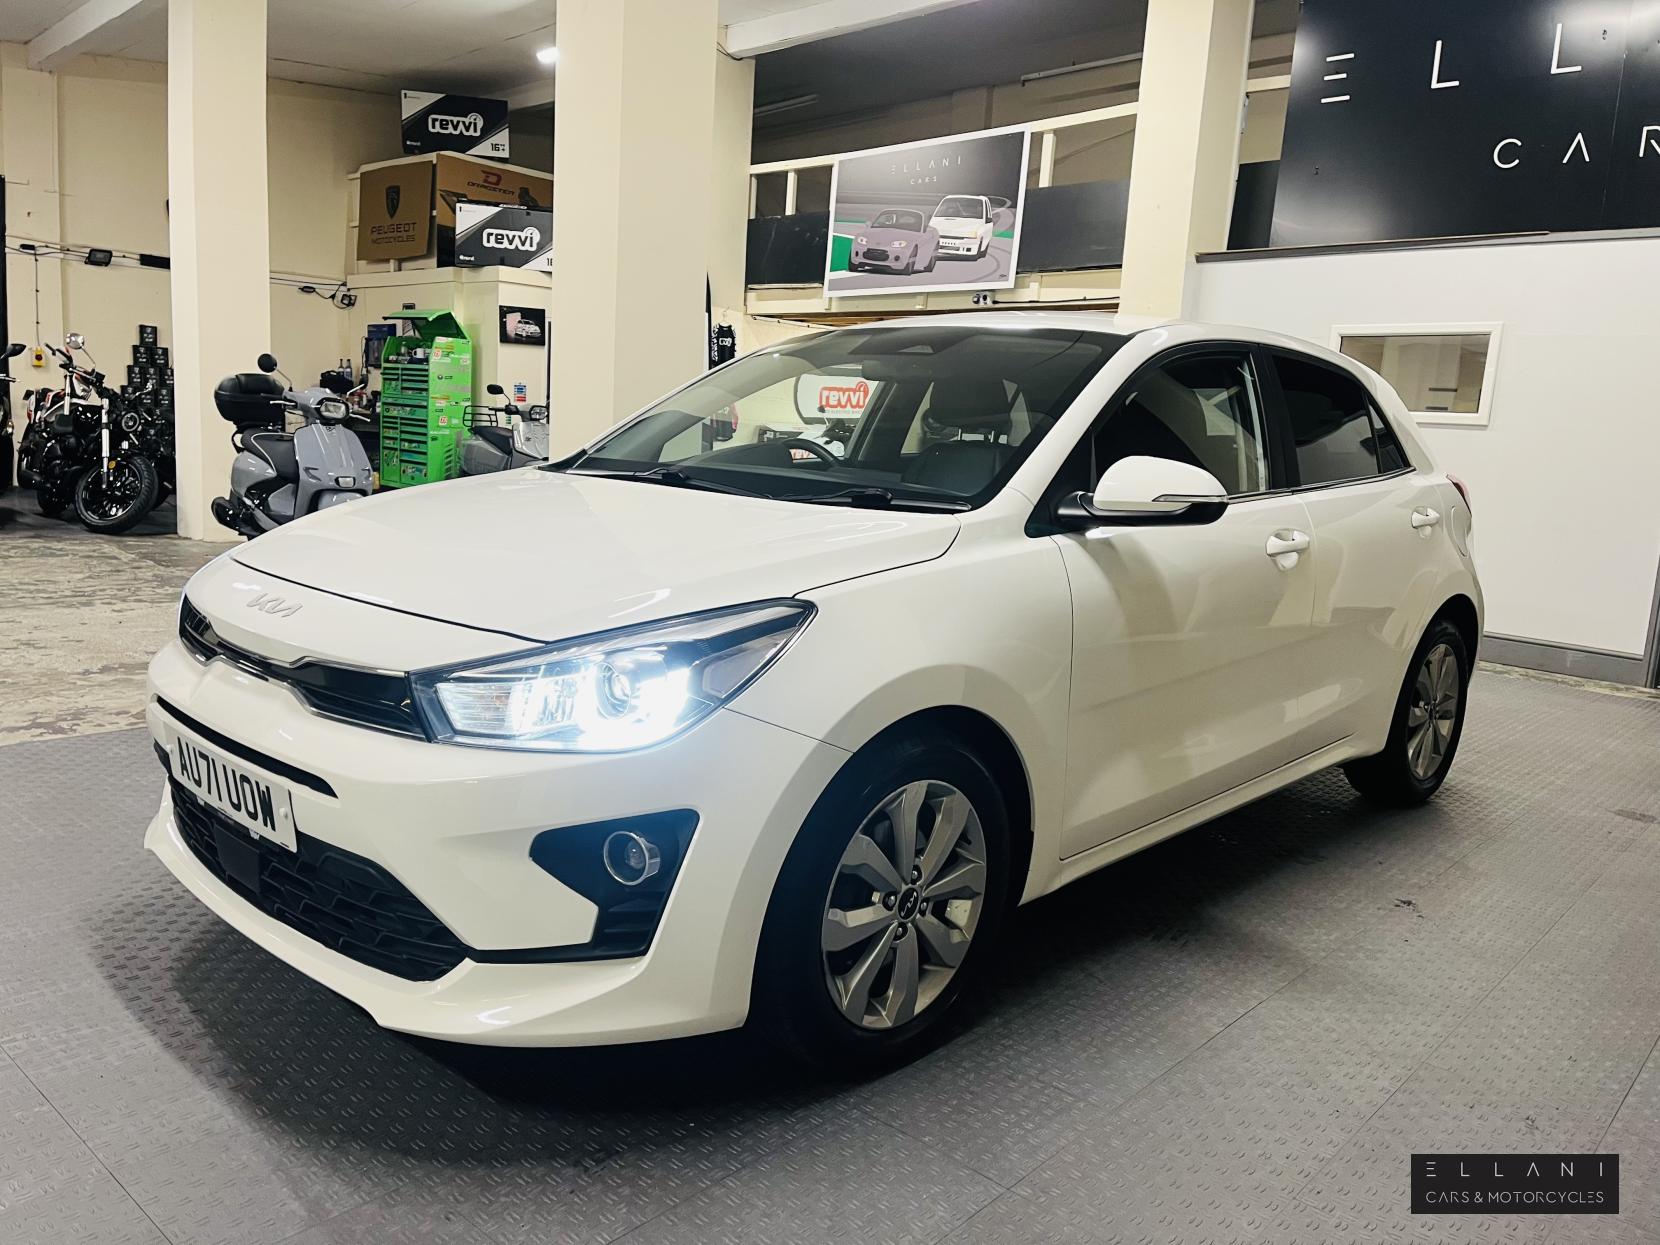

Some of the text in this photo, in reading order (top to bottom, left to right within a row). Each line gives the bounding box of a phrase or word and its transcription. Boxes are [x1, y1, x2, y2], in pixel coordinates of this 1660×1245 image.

[430, 115, 480, 135] revvi
[889, 155, 961, 175] ELLANI
[910, 175, 937, 185] CARS
[370, 222, 417, 235] PEUGEOT
[485, 229, 536, 249] revvi
[820, 382, 866, 408] revvi
[177, 735, 276, 832] AU71 UOW
